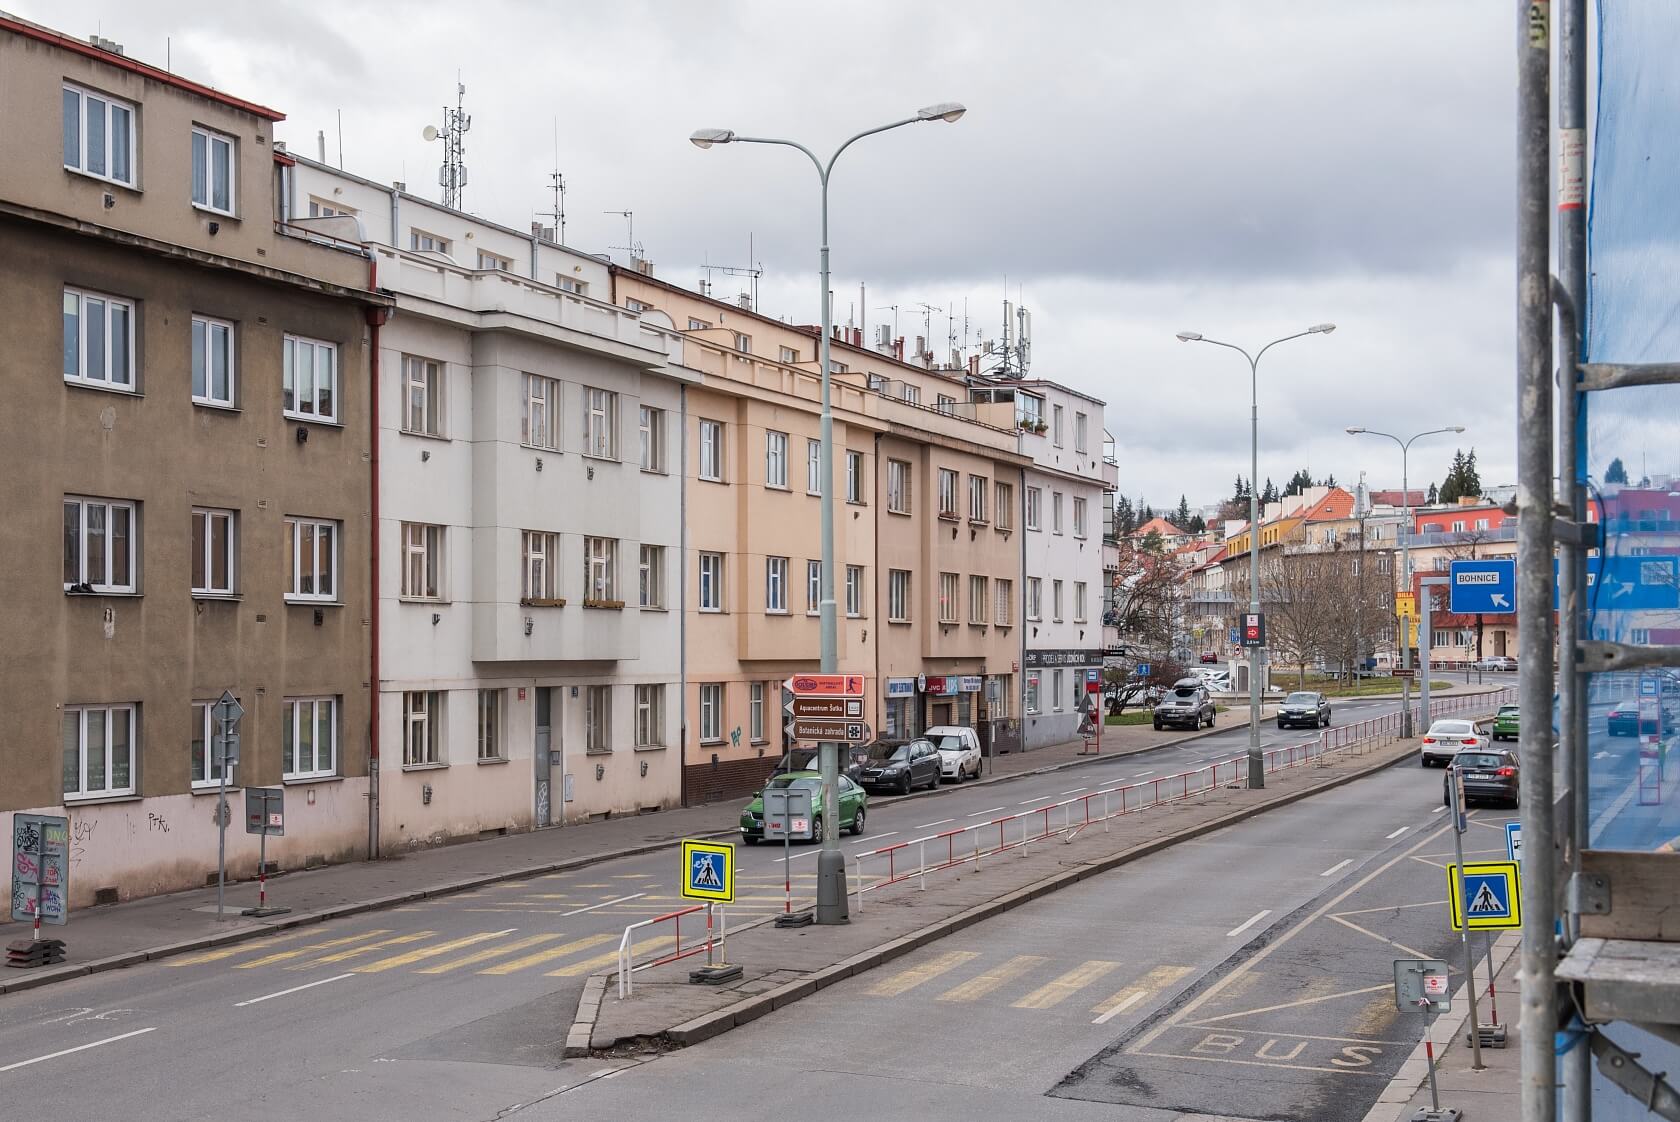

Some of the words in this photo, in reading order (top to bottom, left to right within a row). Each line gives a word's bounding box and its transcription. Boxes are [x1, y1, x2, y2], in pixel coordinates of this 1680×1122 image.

[1459, 574, 1497, 583] BOHNICE
[799, 704, 828, 712] Aquacentrum
[829, 703, 843, 712] Šutka
[799, 726, 823, 735] Botanická
[824, 727, 844, 736] zahrada
[1190, 1034, 1382, 1067] BUS
